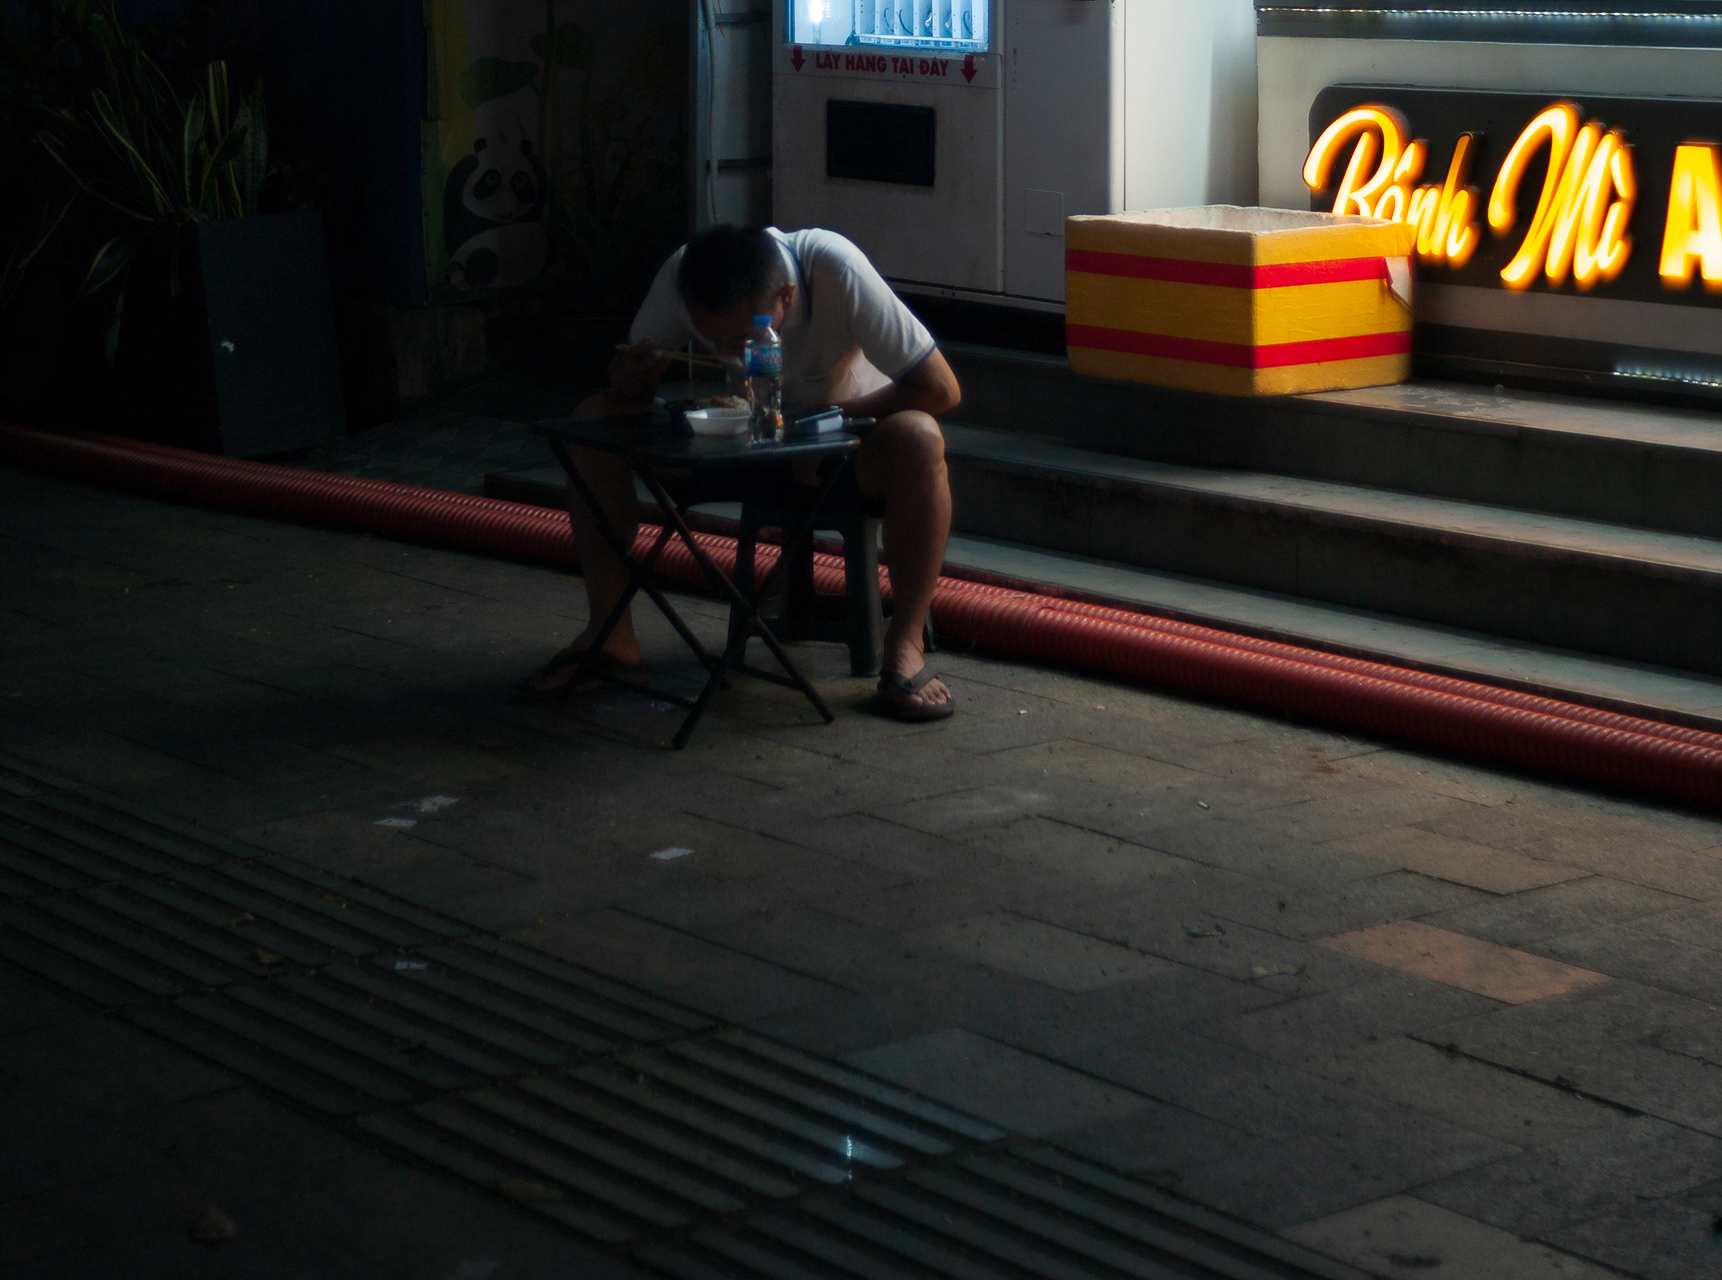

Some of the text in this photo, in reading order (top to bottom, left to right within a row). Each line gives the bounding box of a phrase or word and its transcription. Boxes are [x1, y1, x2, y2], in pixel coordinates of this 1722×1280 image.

[816, 49, 949, 78] LẤY HÀNG TẠI ĐÂY
[1302, 104, 1480, 258] Bánh
[1488, 101, 1637, 283] Mì
